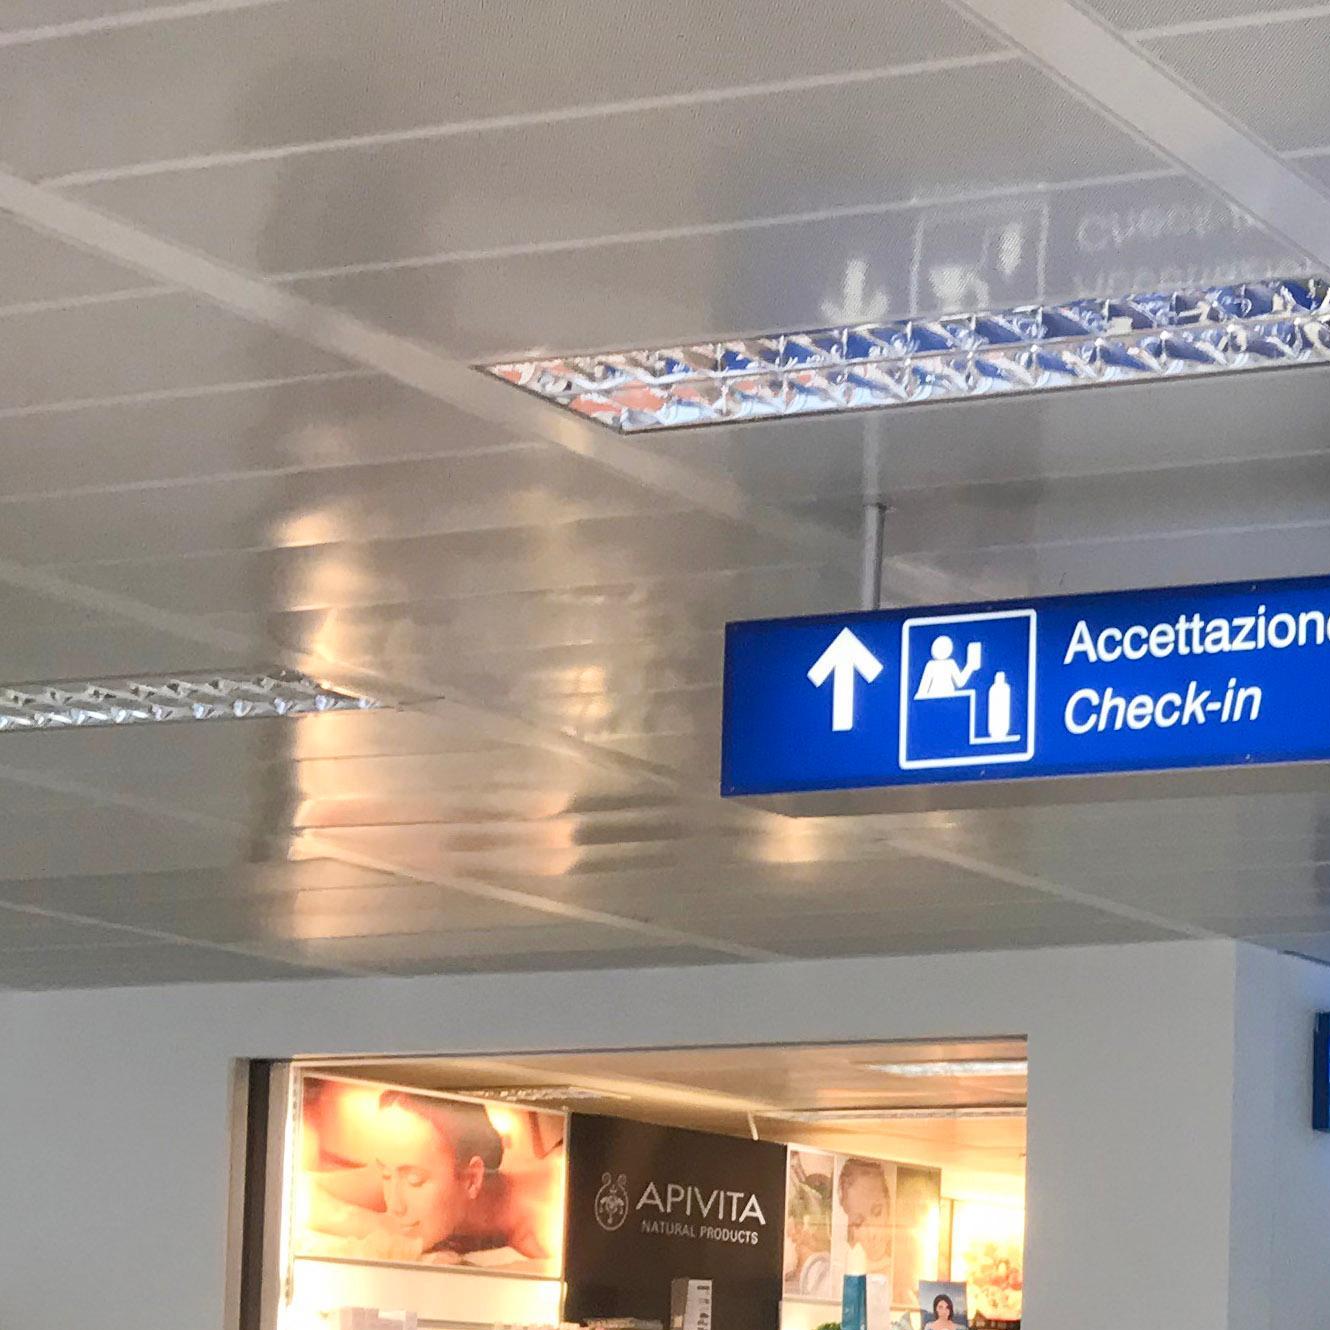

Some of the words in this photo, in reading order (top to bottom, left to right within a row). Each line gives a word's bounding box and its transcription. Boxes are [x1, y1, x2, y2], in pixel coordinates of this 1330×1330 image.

[1064, 677, 1262, 735] Check-in
[636, 1182, 767, 1226] APIVITA
[641, 1219, 696, 1238] NATURAL
[700, 1225, 759, 1245] PRODUCTS
